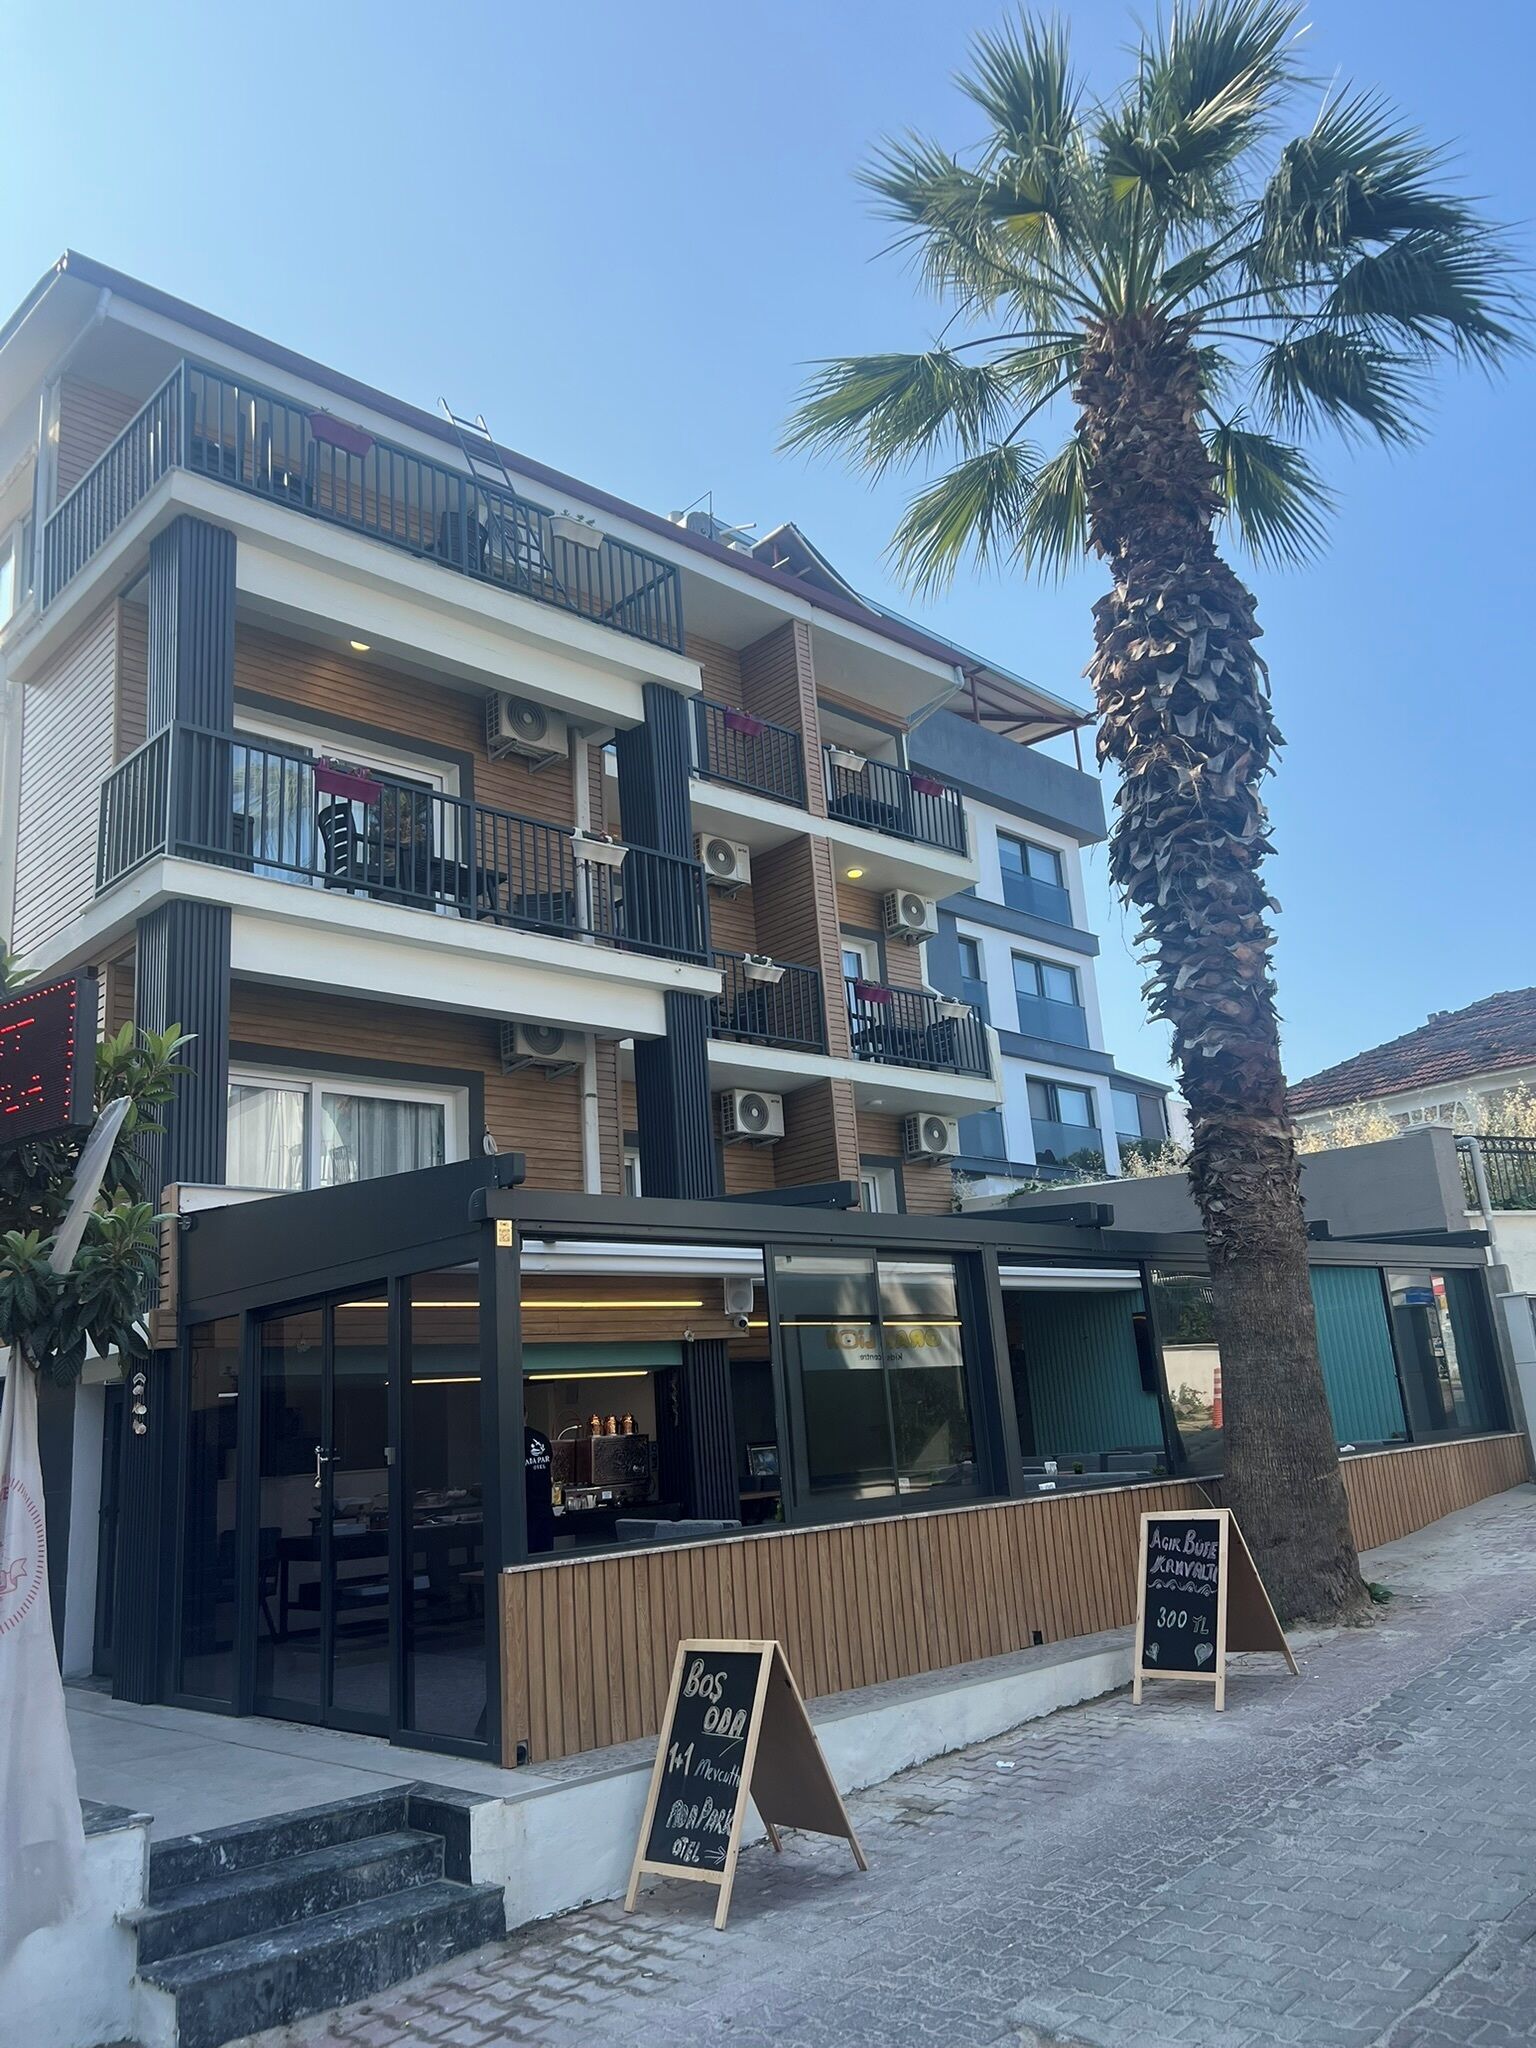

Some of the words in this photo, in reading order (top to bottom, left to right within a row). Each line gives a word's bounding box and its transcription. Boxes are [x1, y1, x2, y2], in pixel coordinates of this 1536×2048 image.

[1157, 1606, 1188, 1628] 300
[1192, 1615, 1209, 1635] TL
[703, 1705, 748, 1737] ODA
[669, 1742, 695, 1776] 1+1
[672, 1836, 700, 1863] OTEL
